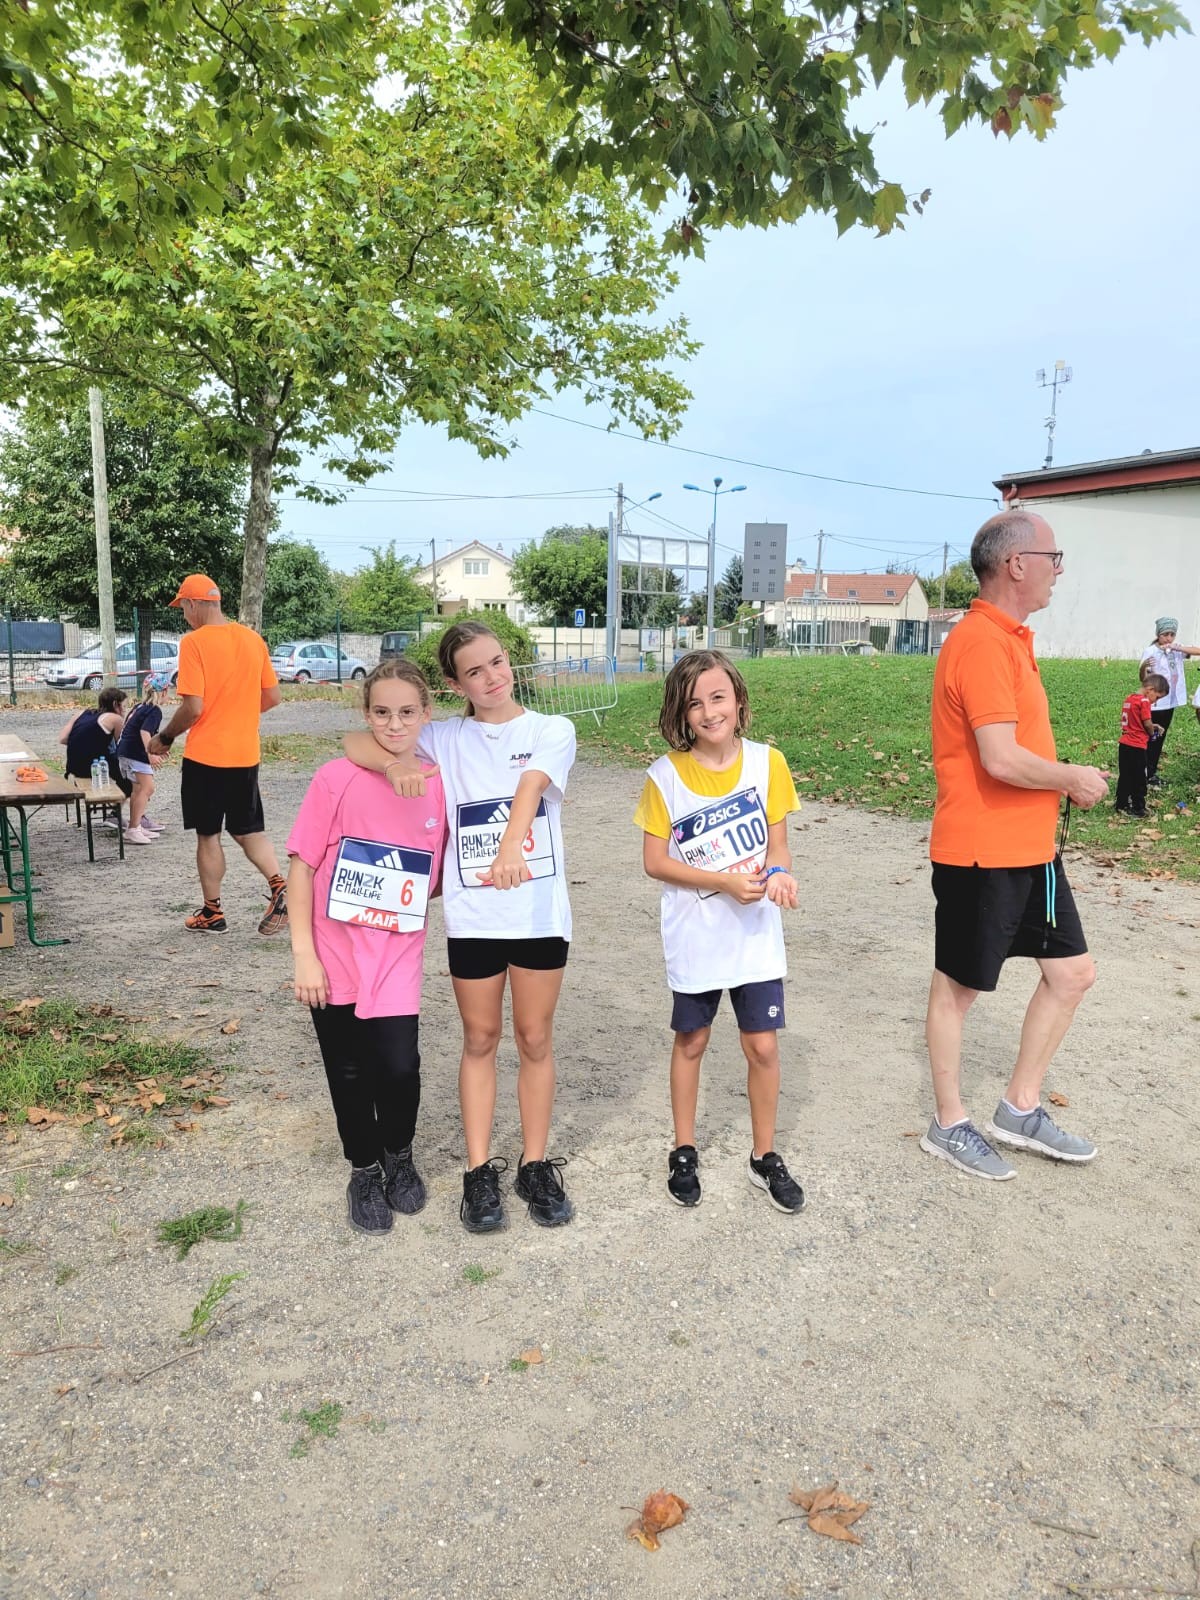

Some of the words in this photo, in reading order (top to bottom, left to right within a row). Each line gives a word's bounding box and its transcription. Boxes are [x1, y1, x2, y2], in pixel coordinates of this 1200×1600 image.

[708, 803, 740, 825] asics
[462, 832, 500, 850] RUN2K
[724, 818, 765, 856] 100
[686, 839, 721, 863] RUN2K
[338, 868, 384, 890] RUN2K
[401, 880, 413, 906] 6
[357, 912, 398, 927] MAIF
